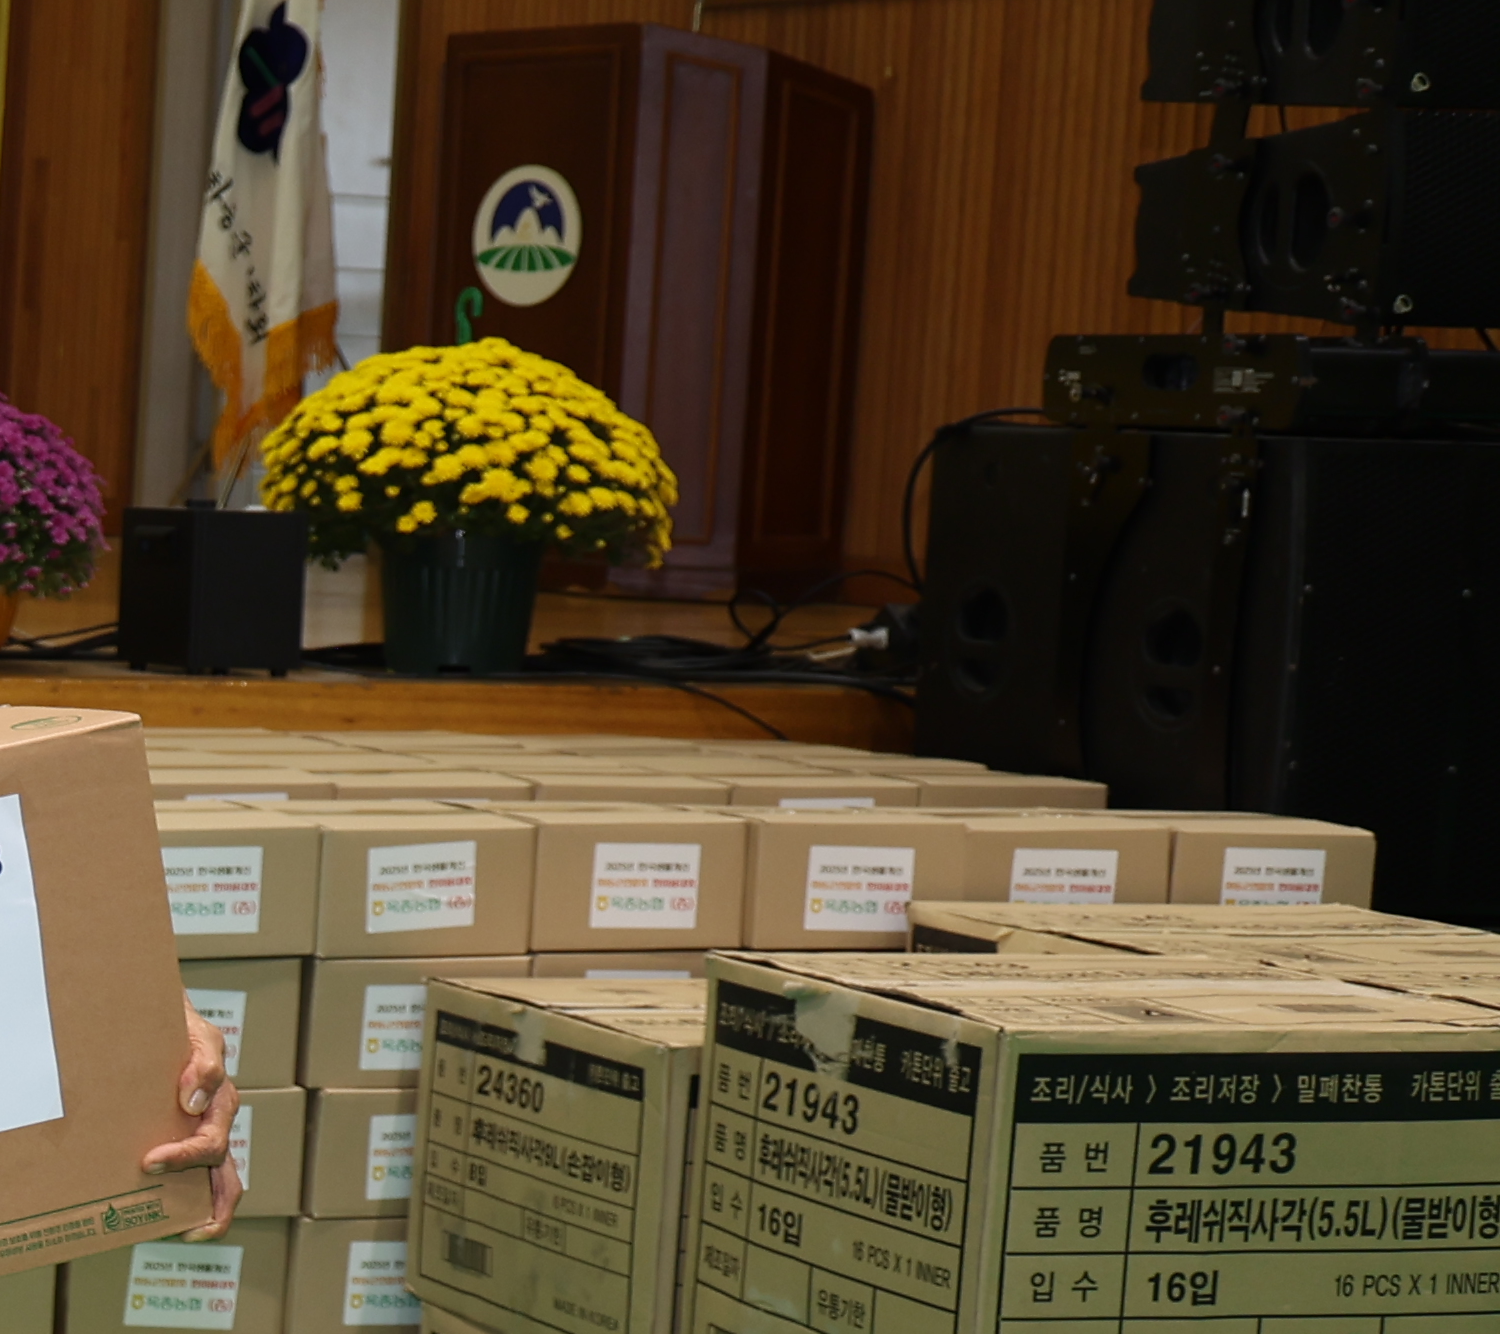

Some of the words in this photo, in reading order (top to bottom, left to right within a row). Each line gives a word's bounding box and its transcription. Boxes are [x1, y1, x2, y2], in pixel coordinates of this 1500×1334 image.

[476, 1064, 545, 1114] 24360
[763, 1071, 860, 1135] 21943
[1030, 1073, 1134, 1105] 조리/식사
[1169, 1072, 1261, 1105] 조리저장
[1296, 1071, 1384, 1104] 밀폐찬통
[1411, 1070, 1481, 1102] 카톤단위
[1039, 1141, 1066, 1174] 품
[1084, 1140, 1110, 1173] 번
[1147, 1132, 1298, 1176] 21943
[757, 1202, 803, 1248] 16입
[1033, 1206, 1061, 1239] 품
[1078, 1205, 1104, 1238] 명
[1030, 1271, 1055, 1304] 입
[1071, 1270, 1099, 1303] 수
[1147, 1270, 1219, 1306] 16입
[1334, 1275, 1354, 1297] 16
[1362, 1274, 1401, 1298] PCS
[1408, 1273, 1422, 1295] X
[1446, 1272, 1500, 1295] INNER
